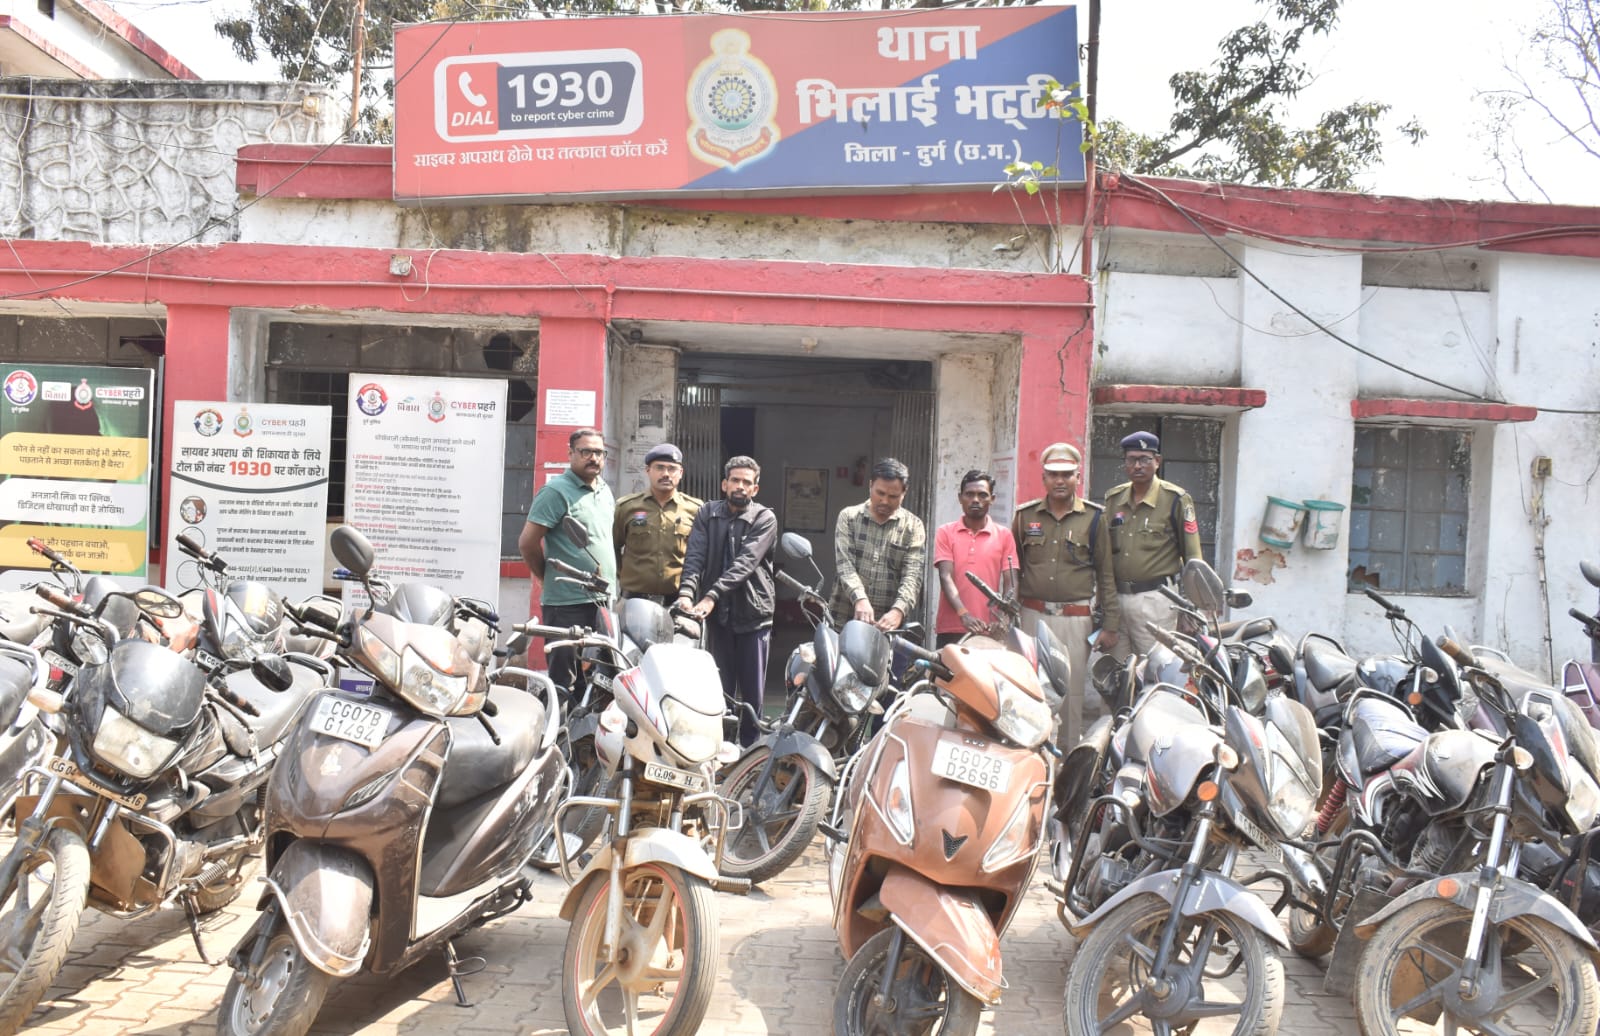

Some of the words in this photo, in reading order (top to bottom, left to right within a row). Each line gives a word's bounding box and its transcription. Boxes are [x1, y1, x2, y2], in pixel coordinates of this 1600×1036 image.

[877, 26, 981, 62] थाना
[507, 70, 613, 109] 1930
[795, 75, 940, 127] भिलाई
[451, 110, 495, 127] DIAL
[511, 113, 522, 123] to
[524, 111, 556, 124] report
[557, 109, 585, 122] cyber
[586, 109, 614, 119] crime
[414, 152, 456, 169] साइबर
[460, 149, 503, 165] अपराध
[507, 145, 533, 163] होने
[536, 147, 554, 161] पर
[558, 146, 607, 160] तत्काल
[610, 140, 642, 158] कॉल
[645, 139, 669, 156] करें
[844, 142, 897, 163] जिला
[916, 140, 947, 167] दुर्ग
[954, 139, 1022, 166] (छ.ग.)
[97, 389, 122, 397] CYBER
[450, 402, 477, 410] CYBER
[477, 401, 496, 411] प्रहरी
[261, 418, 287, 426] CYBER
[13, 444, 28, 453] फोन
[29, 444, 36, 453] से
[51, 446, 62, 454] कर
[63, 447, 84, 455] सकता
[86, 446, 100, 458] कोई
[102, 447, 110, 457] भी
[181, 447, 209, 457] सायबर
[211, 448, 238, 458] अपराध
[242, 447, 253, 458] की
[257, 447, 290, 460] शिकायत
[291, 448, 300, 460] के
[303, 448, 321, 461] लिये
[45, 456, 51, 465] से
[101, 459, 106, 468] है
[176, 460, 192, 472] टोल
[194, 460, 205, 473] फ्री
[206, 463, 225, 473] नंबर
[229, 461, 272, 477] 1930
[274, 465, 286, 475] पर
[287, 464, 306, 476] कॉल
[31, 491, 58, 501] अनजानी
[78, 494, 87, 502] पर
[17, 500, 45, 510] डिजिटल
[79, 504, 91, 512] का
[47, 536, 59, 546] और
[331, 701, 381, 726] CG07B
[324, 717, 375, 742] G1494
[950, 747, 1002, 774] CG07B
[945, 762, 999, 789] D2696
